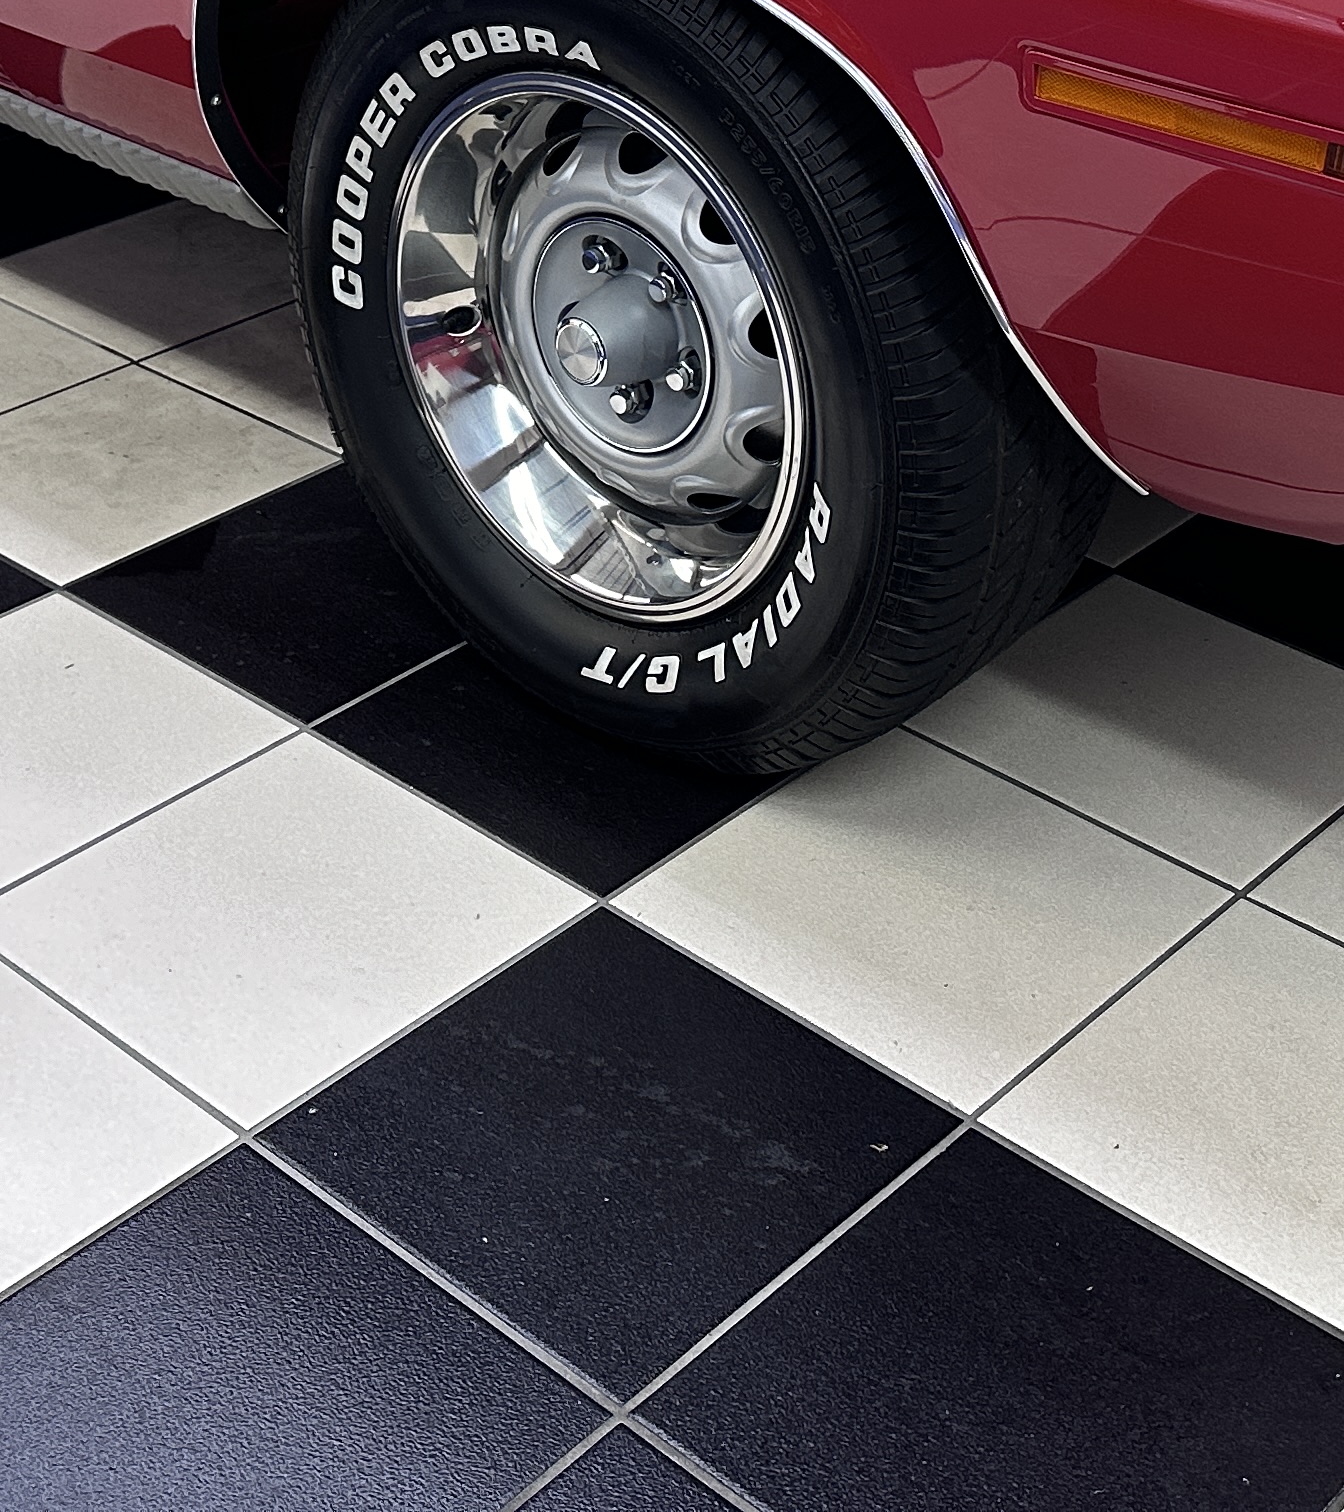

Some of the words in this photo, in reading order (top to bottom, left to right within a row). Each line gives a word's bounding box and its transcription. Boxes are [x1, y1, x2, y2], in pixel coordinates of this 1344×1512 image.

[331, 71, 417, 311] COOPER
[419, 25, 601, 78] COBRA
[581, 646, 680, 695] G/T
[697, 481, 833, 685] RADIAL
